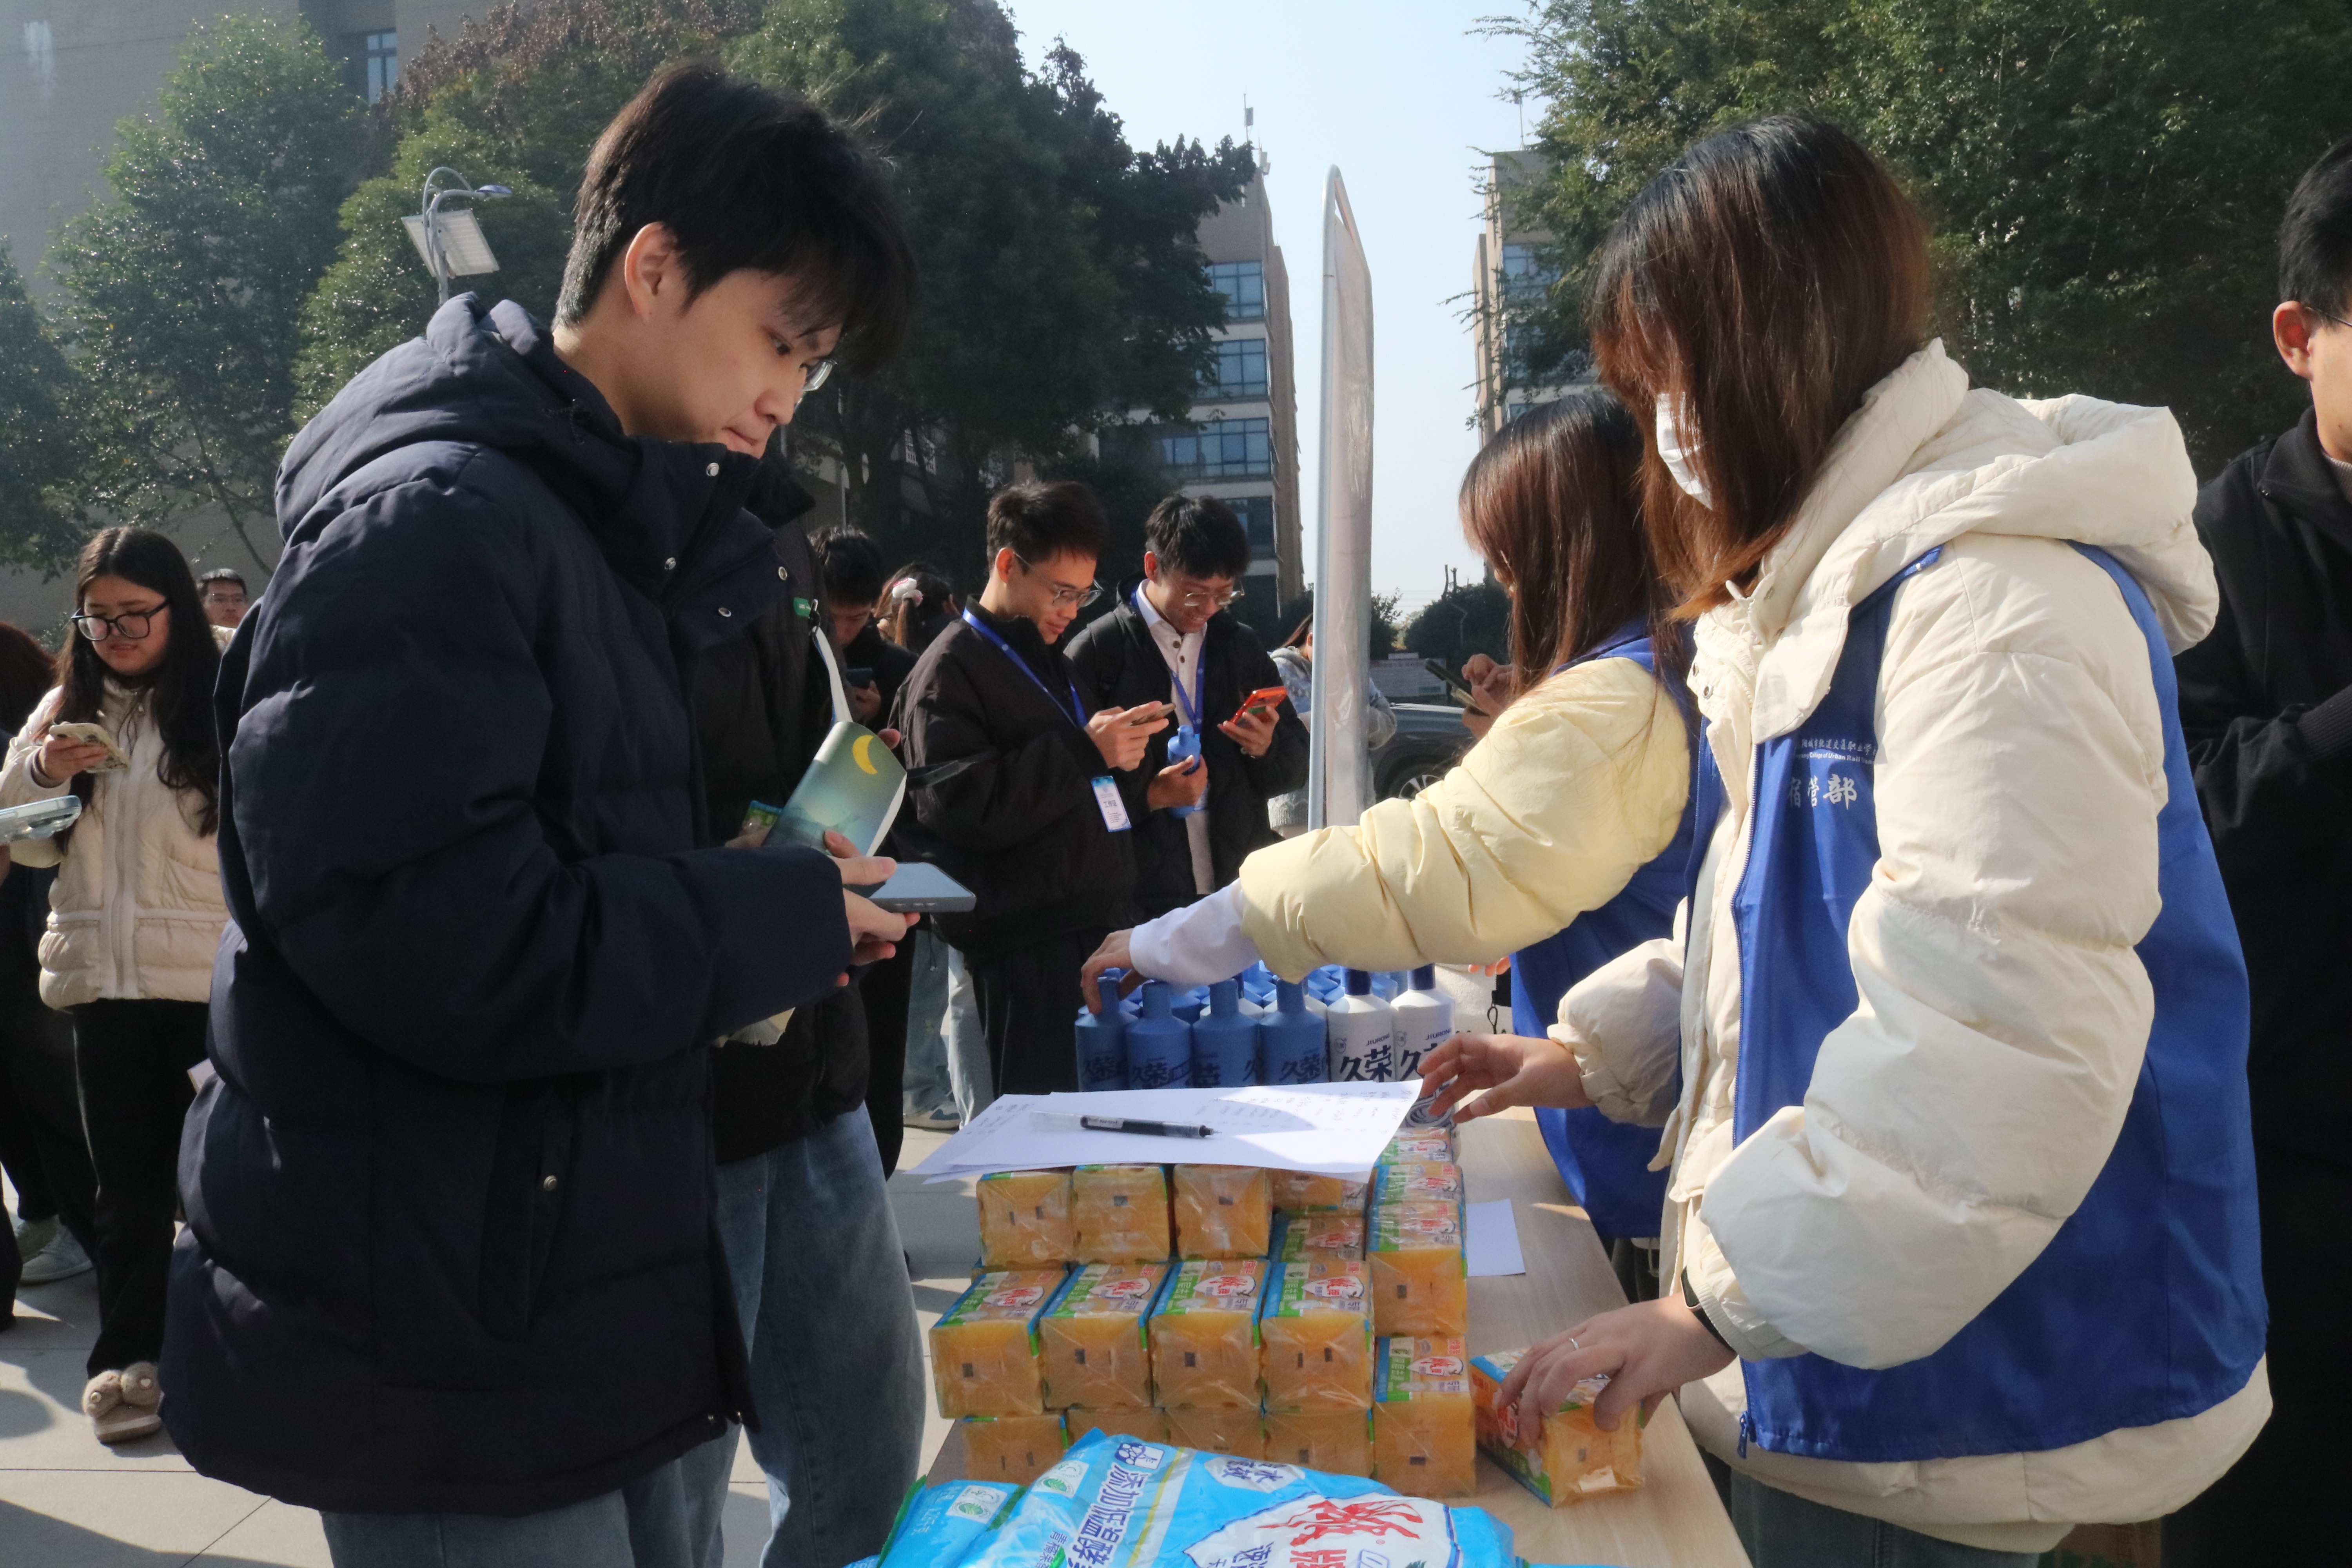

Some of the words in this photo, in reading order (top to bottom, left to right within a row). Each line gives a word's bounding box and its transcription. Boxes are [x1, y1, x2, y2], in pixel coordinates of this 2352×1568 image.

[1339, 1044, 1392, 1083] 久荣
[1068, 1465, 1150, 1568] 添加低温酵
